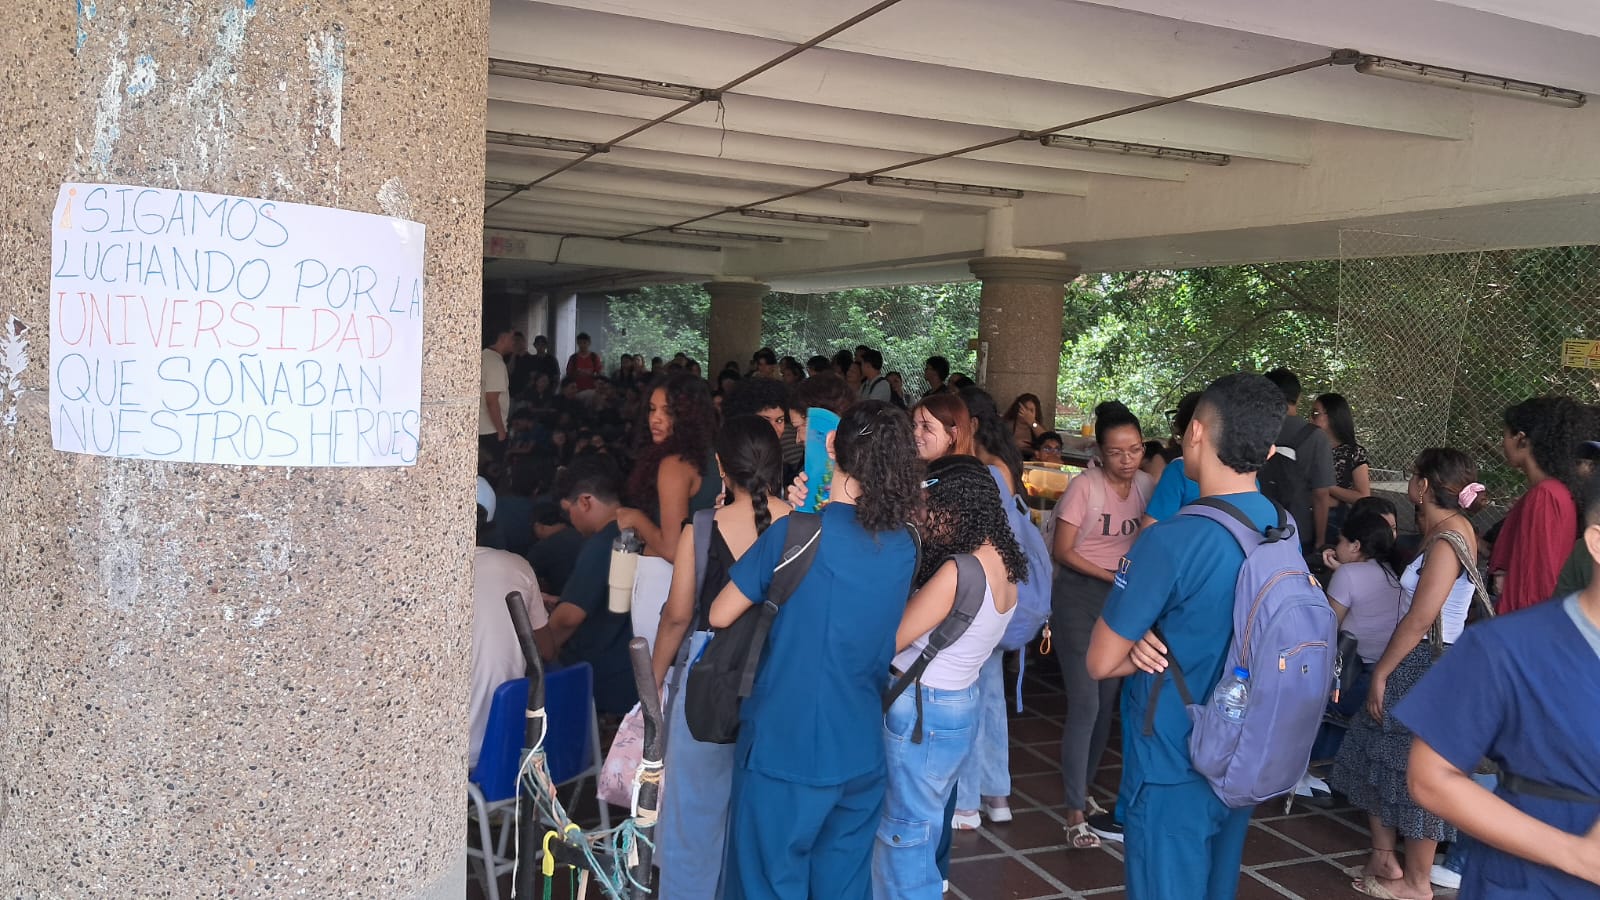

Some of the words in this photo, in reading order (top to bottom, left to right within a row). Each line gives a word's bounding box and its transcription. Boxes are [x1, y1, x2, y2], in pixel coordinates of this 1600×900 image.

[54, 239, 271, 300] LUCHANDO
[294, 258, 381, 315] POR
[389, 275, 420, 319] LA
[57, 291, 393, 359] UNIVERSIDAD
[56, 353, 141, 406] QUE
[156, 353, 382, 412] SOÑABAN
[58, 404, 299, 461] NUESTROS
[310, 409, 421, 464] HEROES
